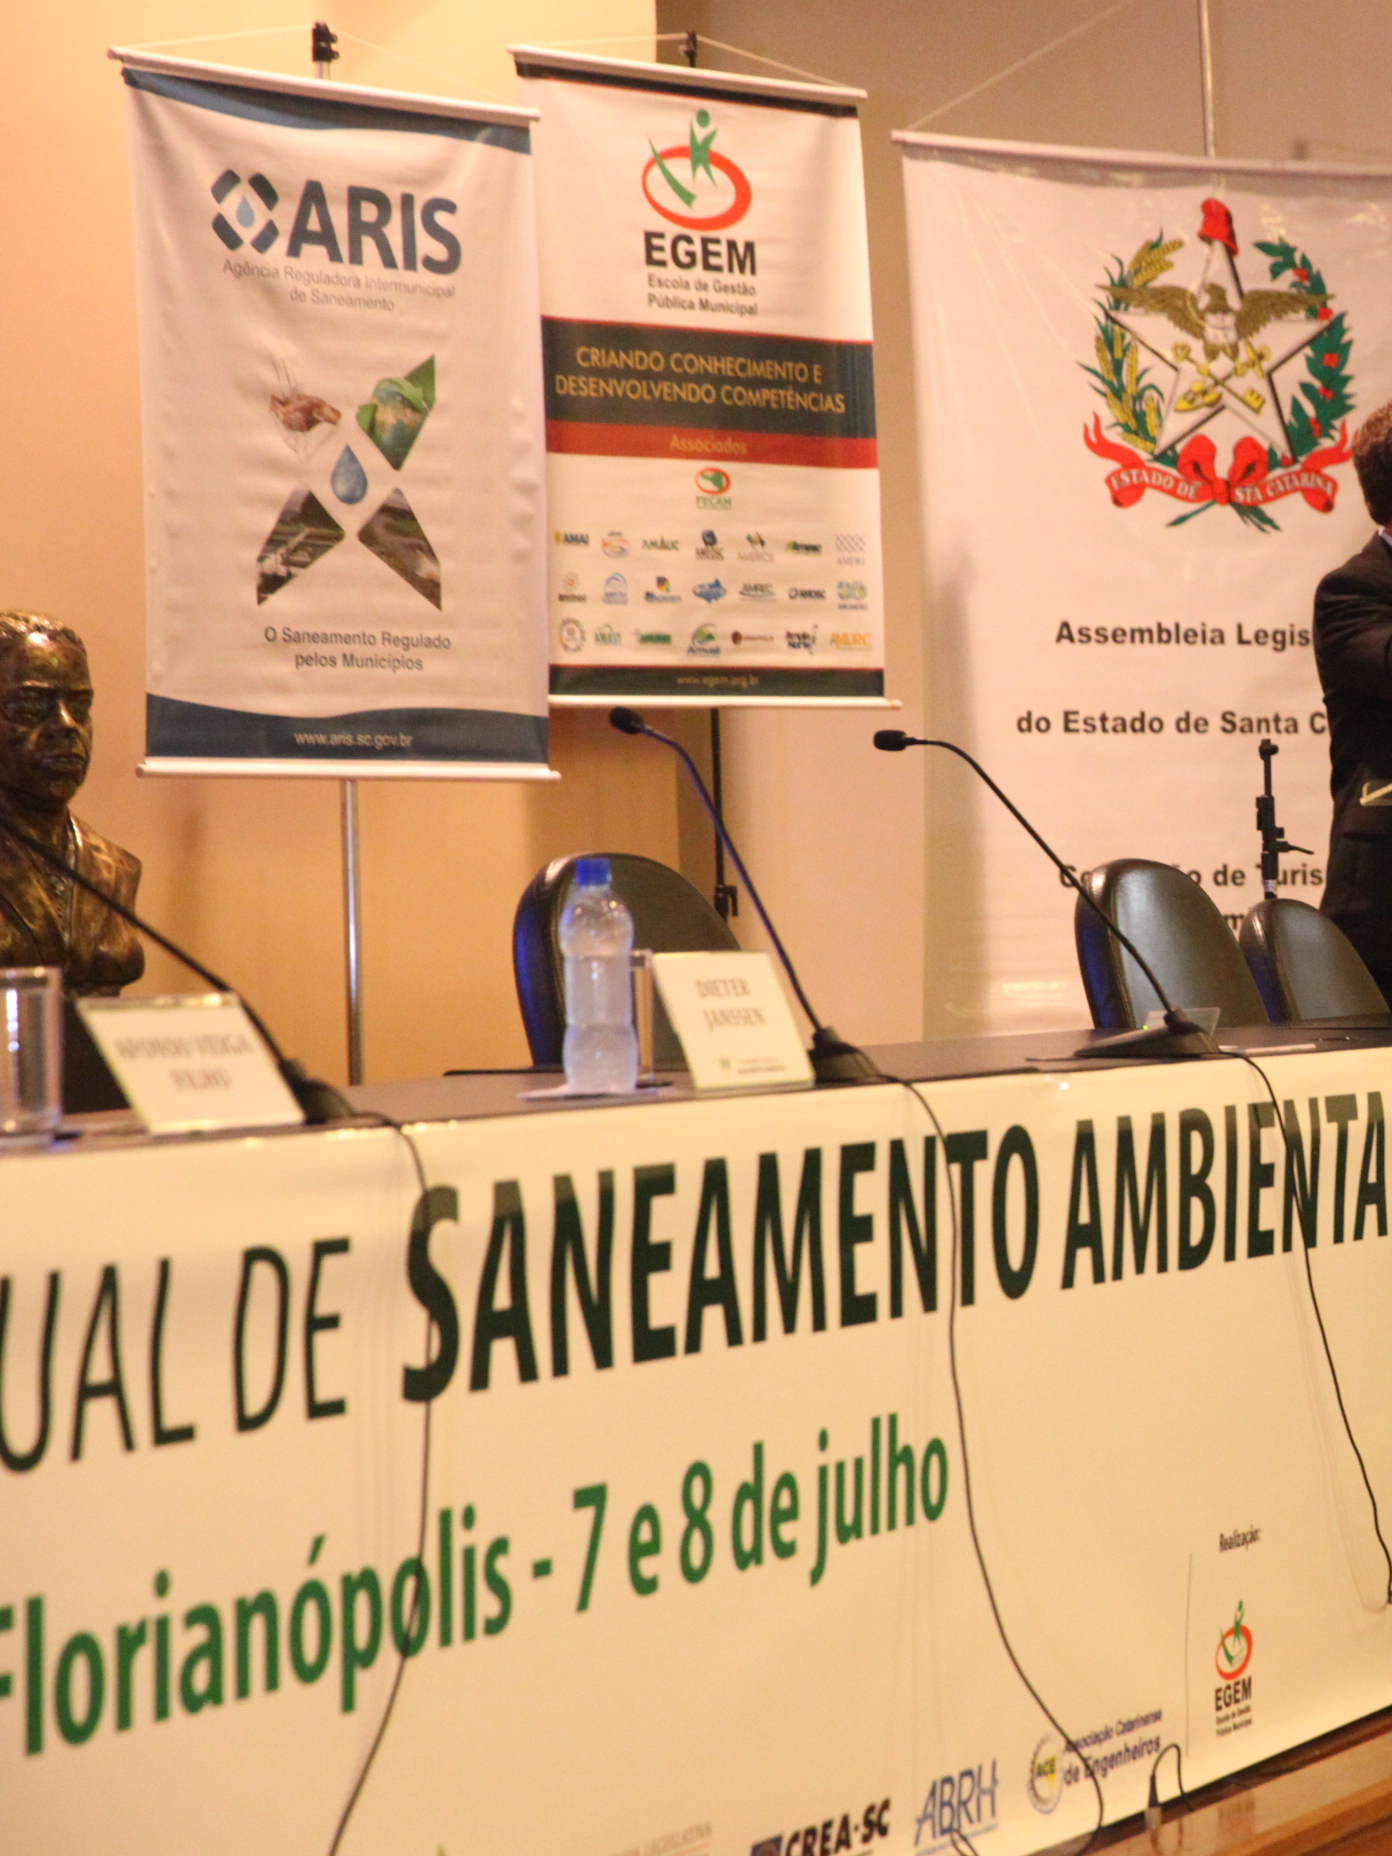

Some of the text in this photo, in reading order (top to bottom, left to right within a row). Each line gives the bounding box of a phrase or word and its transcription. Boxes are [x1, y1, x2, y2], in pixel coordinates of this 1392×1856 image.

[286, 179, 462, 276] ARIS
[643, 231, 757, 276] EGEM
[223, 258, 456, 300] Agência Reguladora Intermunicipal
[647, 273, 757, 298] Escola de Gestão
[290, 288, 396, 312] de Saneamento
[648, 293, 758, 317] Pública Municipal
[576, 346, 822, 384] CRIANDO CONHECIMENTO E
[555, 374, 846, 414] DESENVOLVENDO COMPETÊNCIAS
[1110, 468, 1174, 491] ESTADO
[1234, 486, 1264, 503] STA
[1265, 472, 1334, 498] CATARINA
[264, 627, 451, 651] O Saneamento Regulado
[1055, 620, 1226, 646] Assembleia
[295, 652, 424, 673] pelos Municípios
[1016, 710, 1052, 734] do
[1062, 710, 1164, 734] Estado
[1175, 710, 1210, 734] de
[1219, 710, 1299, 735] Santa
[1213, 863, 1246, 887] de
[1255, 863, 1324, 887] uris
[232, 1236, 353, 1435] DE
[402, 1124, 1040, 1403] SANEAMENTO
[573, 1481, 608, 1614] 7
[627, 1502, 662, 1597] e
[679, 1459, 714, 1585] 8
[730, 1440, 800, 1573] de
[809, 1412, 949, 1588] julho
[1214, 1675, 1252, 1712] EGEM
[1064, 1736, 1161, 1786] de Engenheiros
[914, 1758, 1000, 1847] ABRH
